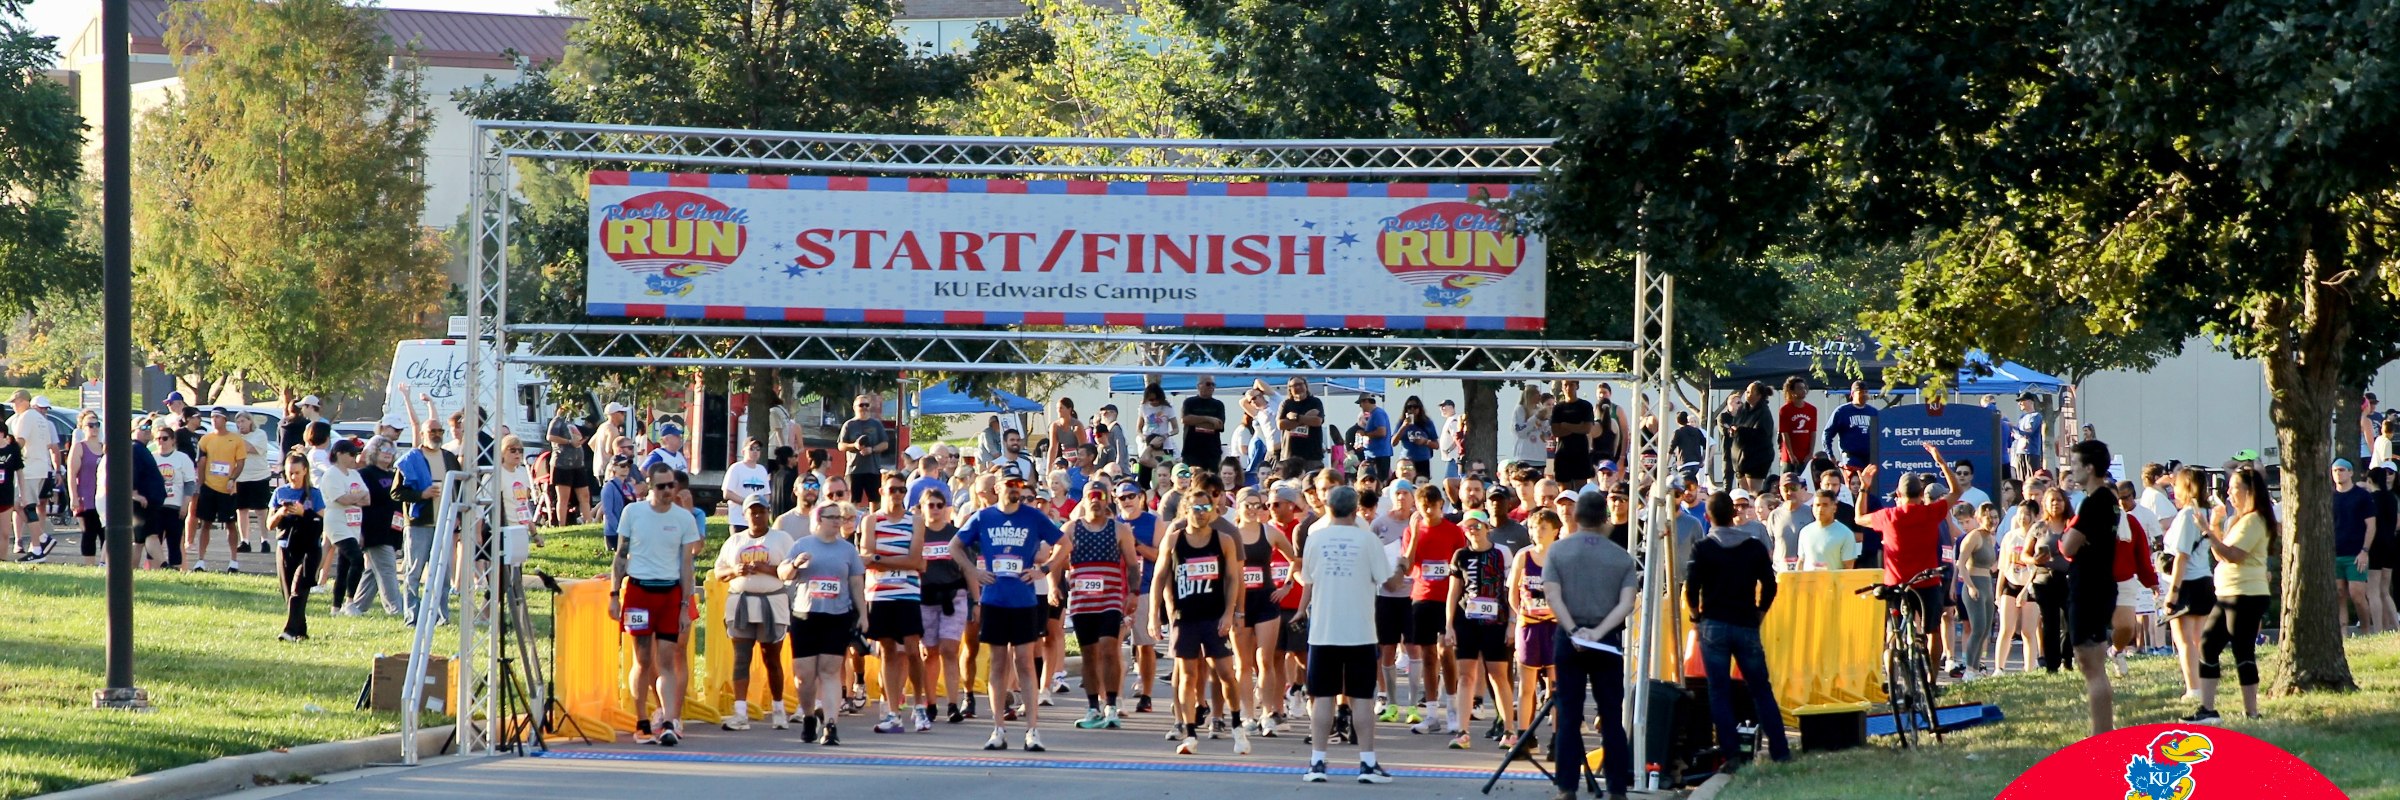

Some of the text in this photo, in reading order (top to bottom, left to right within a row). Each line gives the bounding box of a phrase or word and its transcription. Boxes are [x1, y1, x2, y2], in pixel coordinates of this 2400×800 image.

[602, 202, 750, 224] Rock Chalk
[1378, 213, 1524, 233] Rock Cha
[608, 219, 738, 256] RUN
[795, 228, 1326, 275] START/FINISH
[1385, 230, 1517, 267] RUN
[660, 279, 677, 287] KU
[934, 281, 1197, 303] KU Edwards Campus
[1895, 427, 1961, 438] BEST Building
[1947, 437, 1974, 446] Center
[1895, 460, 1932, 470] Regents
[987, 526, 1029, 539] KANSAS
[991, 537, 1025, 547] JAYHAWKS
[1006, 561, 1018, 571] 39
[1199, 563, 1216, 573] 319
[1434, 566, 1445, 575] 26
[1244, 573, 1260, 582] 378
[821, 582, 838, 592] 296
[1085, 581, 1101, 590] 299
[1481, 604, 1492, 613] 90
